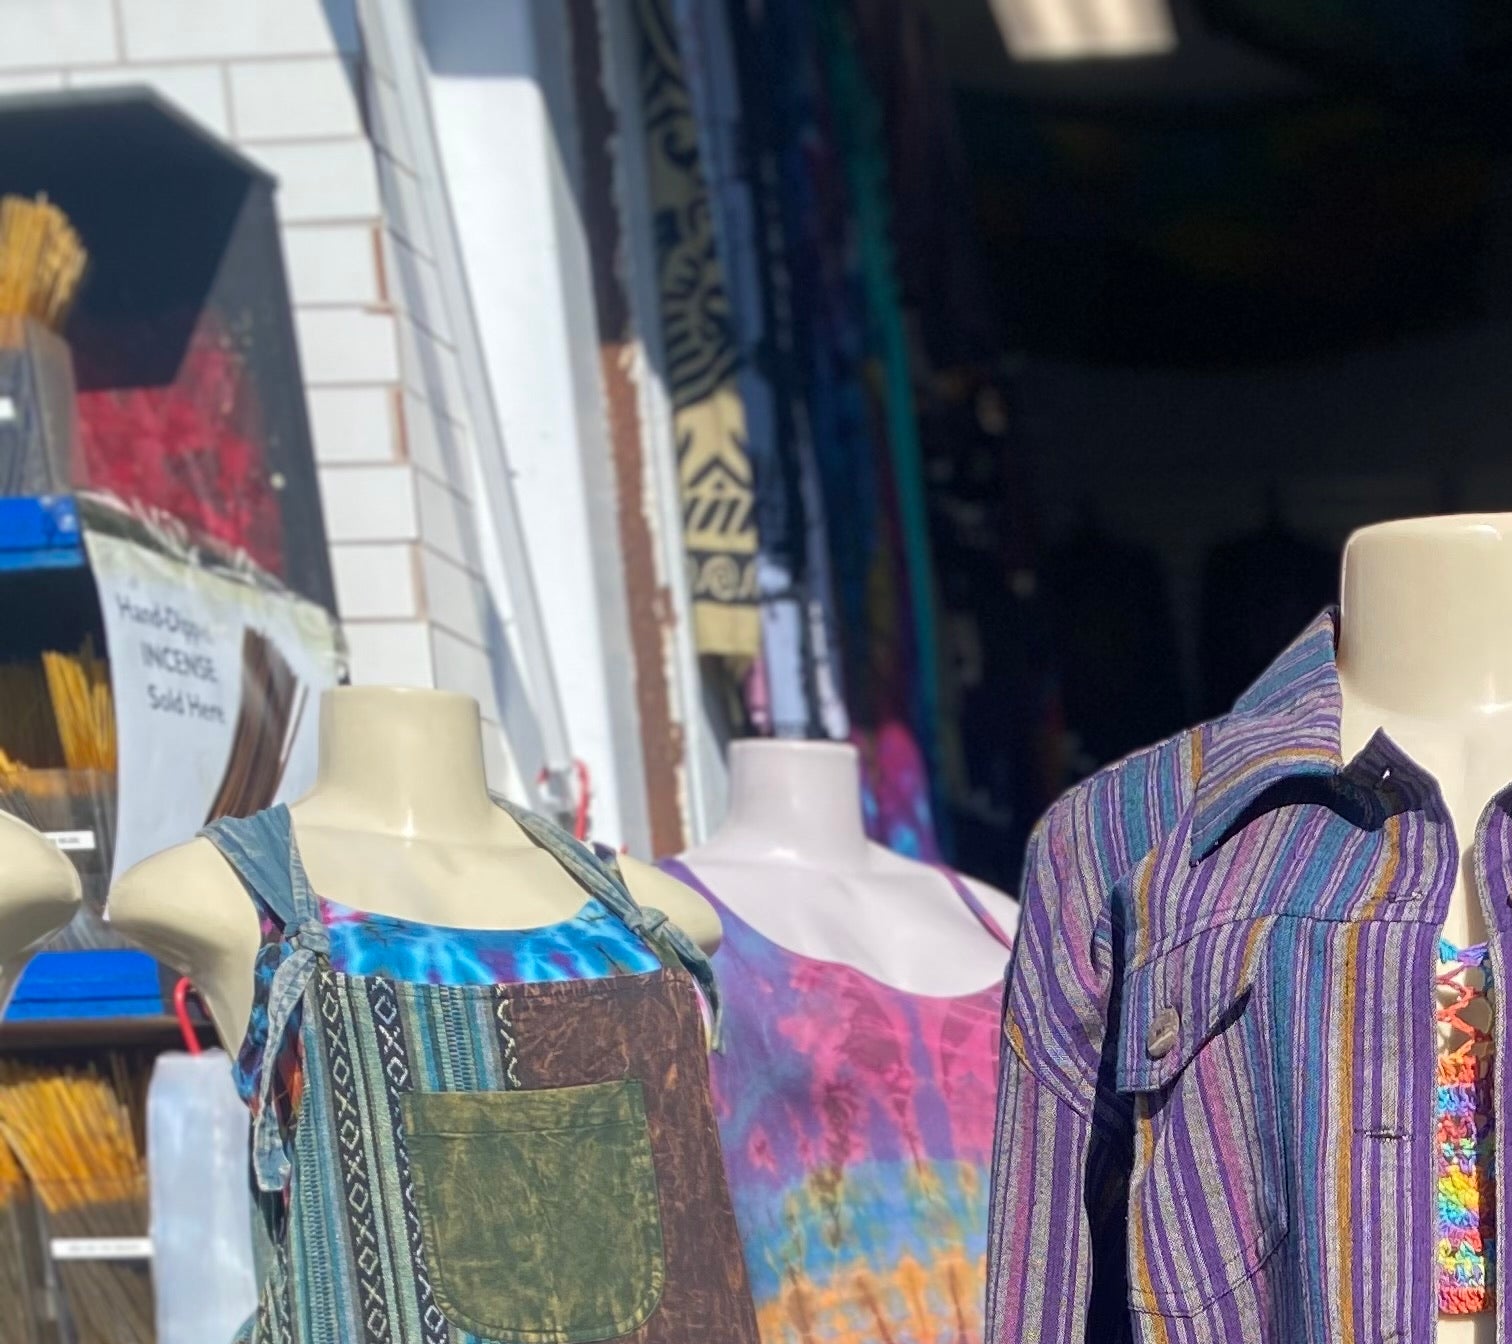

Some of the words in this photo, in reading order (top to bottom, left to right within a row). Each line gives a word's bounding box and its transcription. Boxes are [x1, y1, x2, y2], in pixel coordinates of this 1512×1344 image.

[141, 641, 219, 683] INCENSE
[147, 683, 185, 716] Sold
[186, 692, 225, 724] Here
